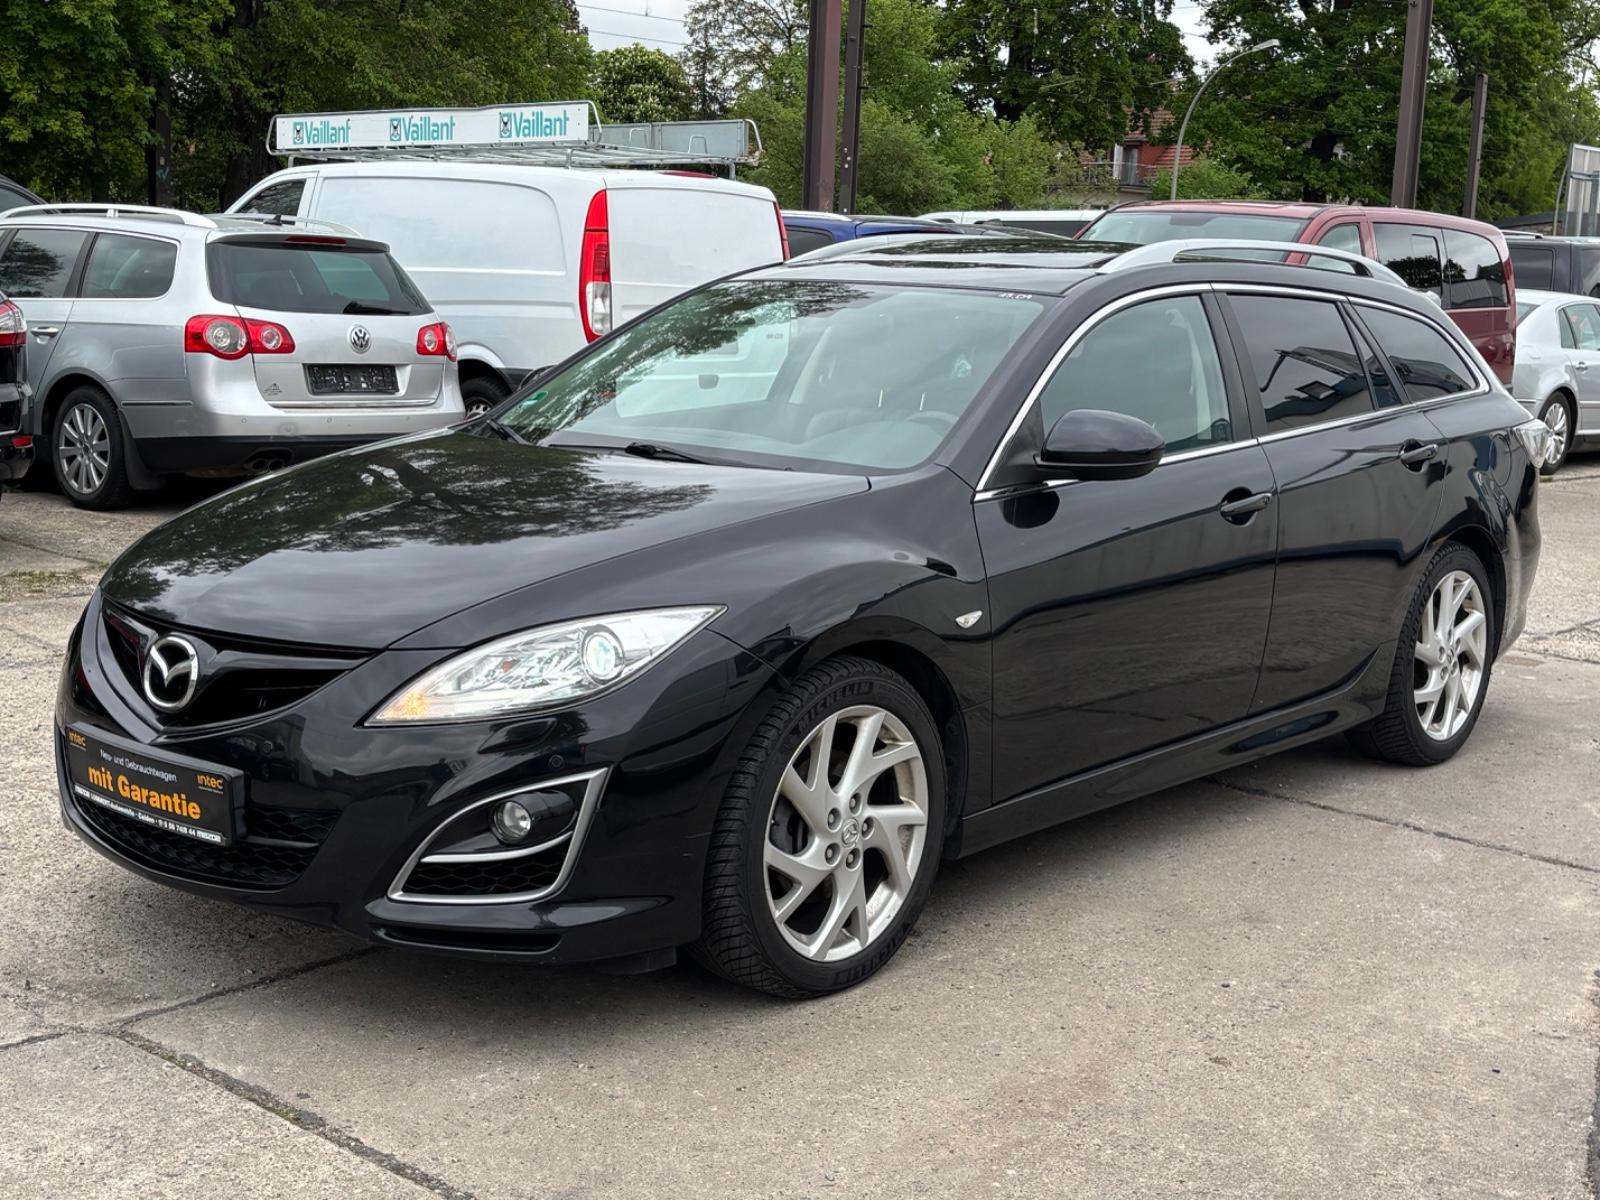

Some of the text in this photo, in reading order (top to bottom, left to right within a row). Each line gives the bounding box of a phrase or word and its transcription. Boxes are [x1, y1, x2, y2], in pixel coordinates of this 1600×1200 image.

[305, 110, 569, 144] Vaillant Vaillant Vaillant
[114, 755, 124, 766] und
[88, 767, 113, 791] mit
[117, 774, 201, 819] Garantie
[197, 774, 223, 790] intec
